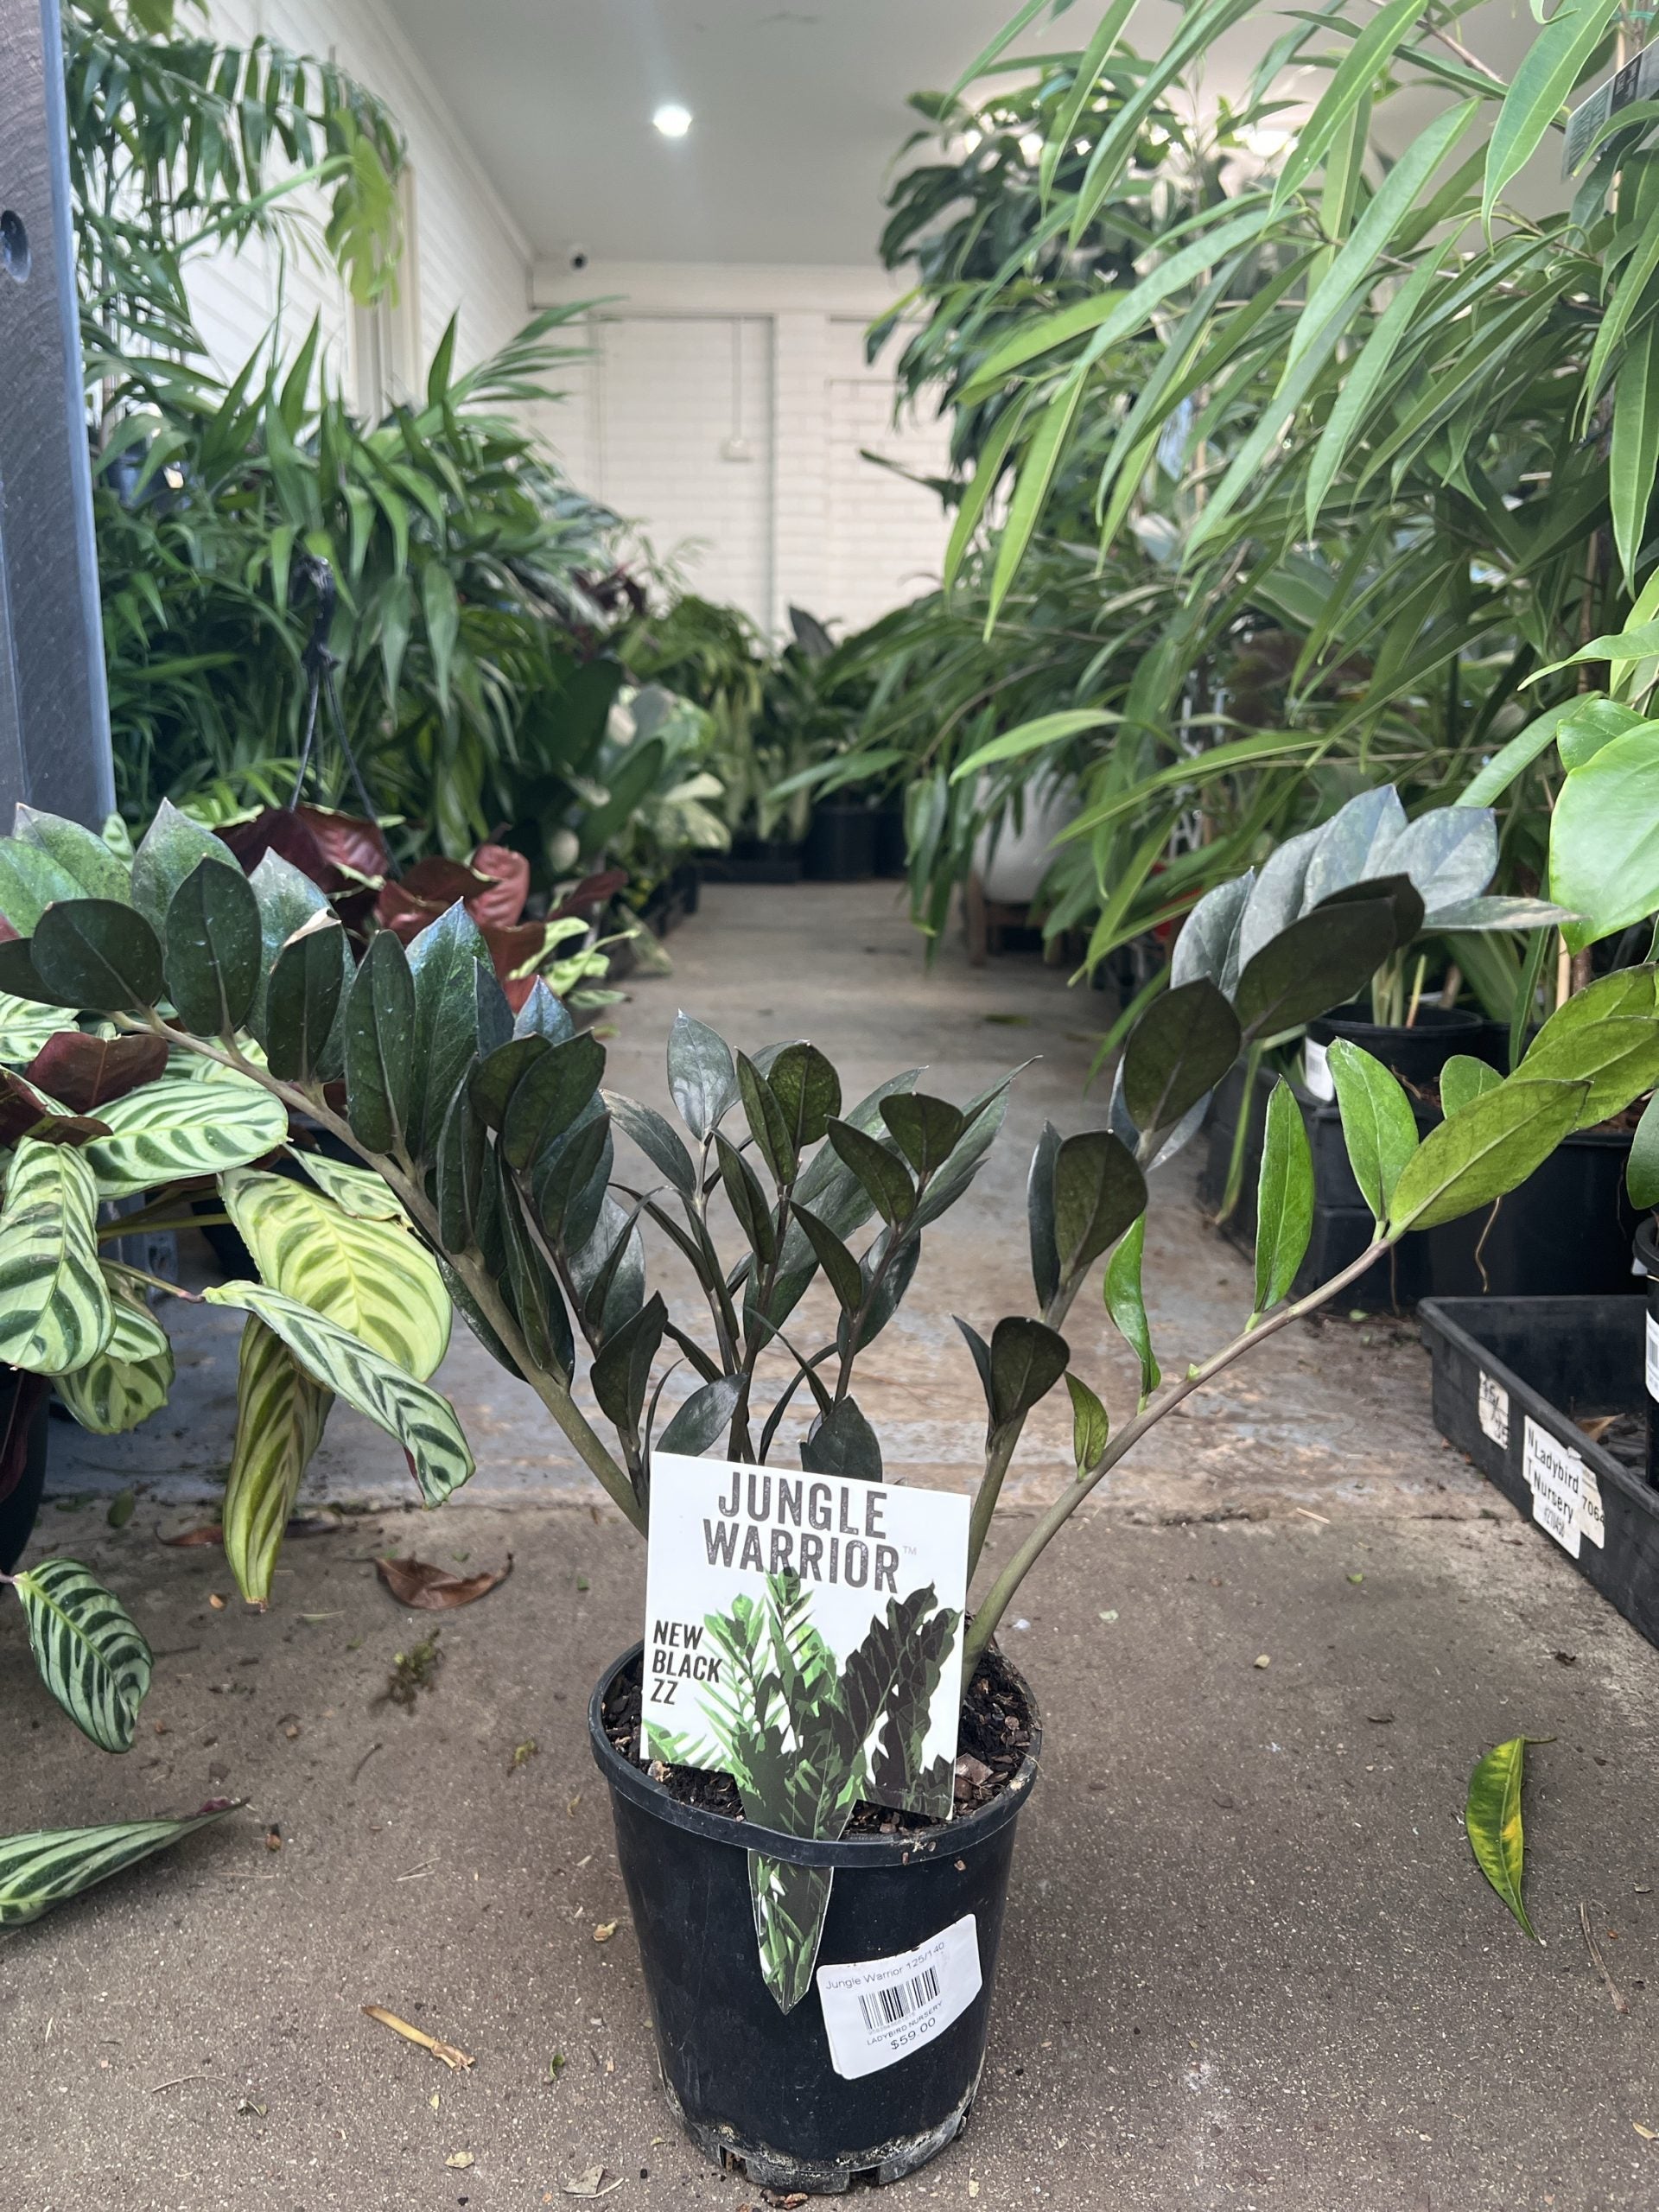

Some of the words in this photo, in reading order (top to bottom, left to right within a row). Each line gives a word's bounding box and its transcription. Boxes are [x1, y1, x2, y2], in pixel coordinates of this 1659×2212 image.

[1535, 1440, 1580, 1495] Ladybird
[719, 1471, 887, 1540] JUNGLE
[1534, 1471, 1574, 1524] Nursery
[703, 1518, 900, 1594] WARRIOR
[653, 1620, 704, 1650] NEW
[652, 1649, 722, 1684] BLACK
[650, 1677, 678, 1706] ZZ
[825, 1975, 861, 1990] Jungle
[863, 1967, 904, 1984] Warrior
[906, 1942, 945, 1971] 125/140
[867, 2024, 907, 2046] LADYBIRD
[908, 2001, 944, 2027] NURSERY
[890, 2017, 937, 2050] $59.00
